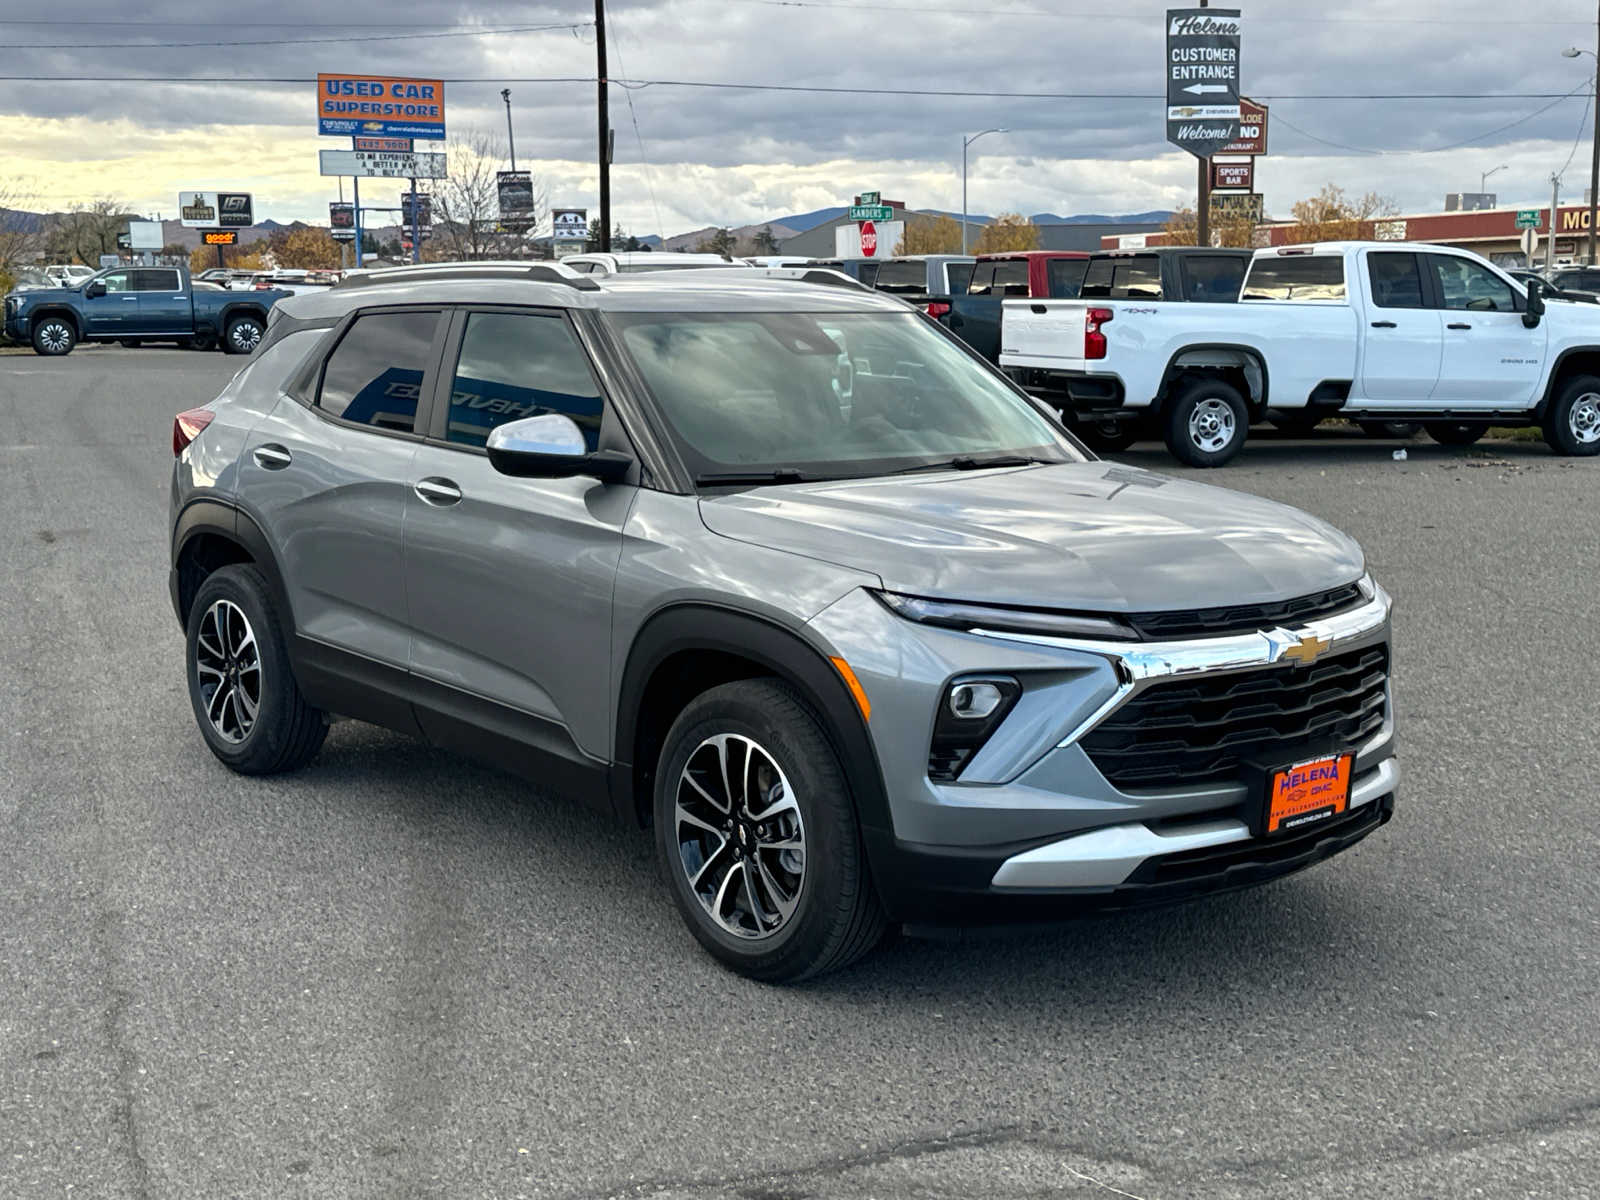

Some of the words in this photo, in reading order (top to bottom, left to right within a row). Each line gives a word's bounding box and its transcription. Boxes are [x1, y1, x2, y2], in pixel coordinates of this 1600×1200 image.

[1175, 16, 1239, 34] Helena
[1172, 48, 1236, 62] CUSTOMER
[1172, 65, 1236, 79] ENTRANCE
[327, 80, 385, 97] USED
[391, 83, 435, 99] CAR
[323, 100, 439, 117] SUPERSTORE
[1177, 124, 1233, 140] Welcome!
[1220, 168, 1248, 177] SPORTS
[1226, 177, 1241, 185] BAR
[862, 233, 877, 249] STOP
[1279, 765, 1339, 795] HELENA
